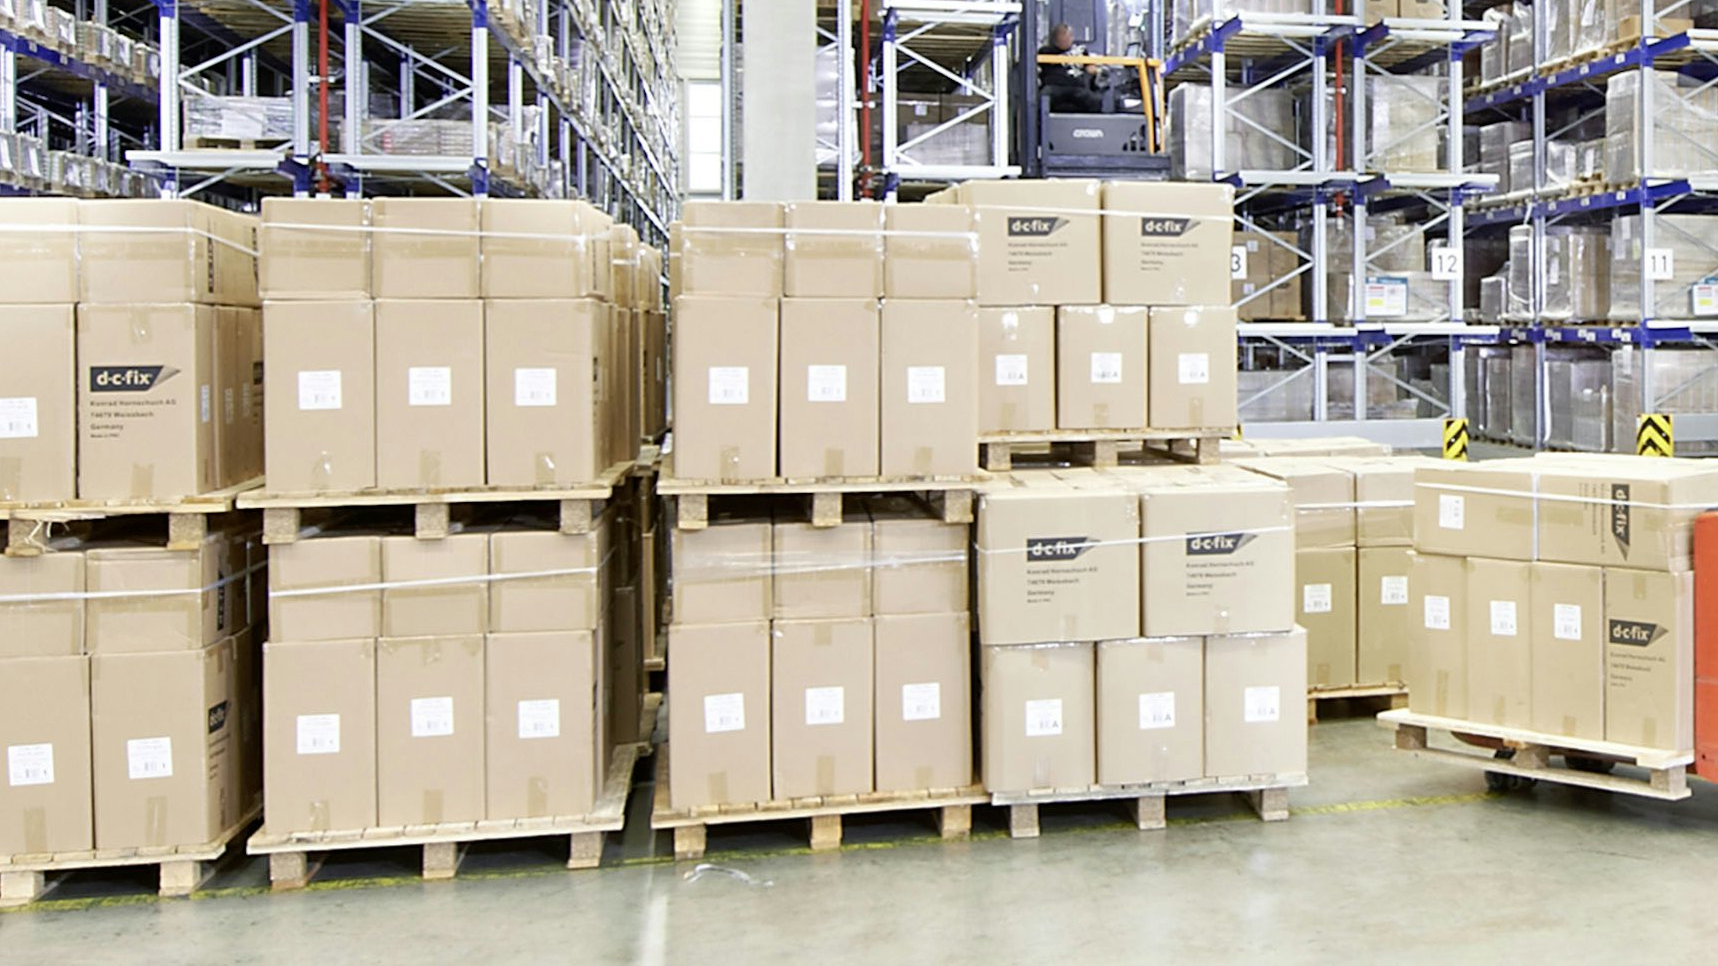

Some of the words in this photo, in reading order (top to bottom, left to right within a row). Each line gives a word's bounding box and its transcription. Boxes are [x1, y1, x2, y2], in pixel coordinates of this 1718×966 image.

[1437, 256, 1458, 273] 12
[1651, 255, 1667, 273] 11
[96, 369, 151, 386] d-c-fix
[1615, 489, 1627, 535] dc-fix
